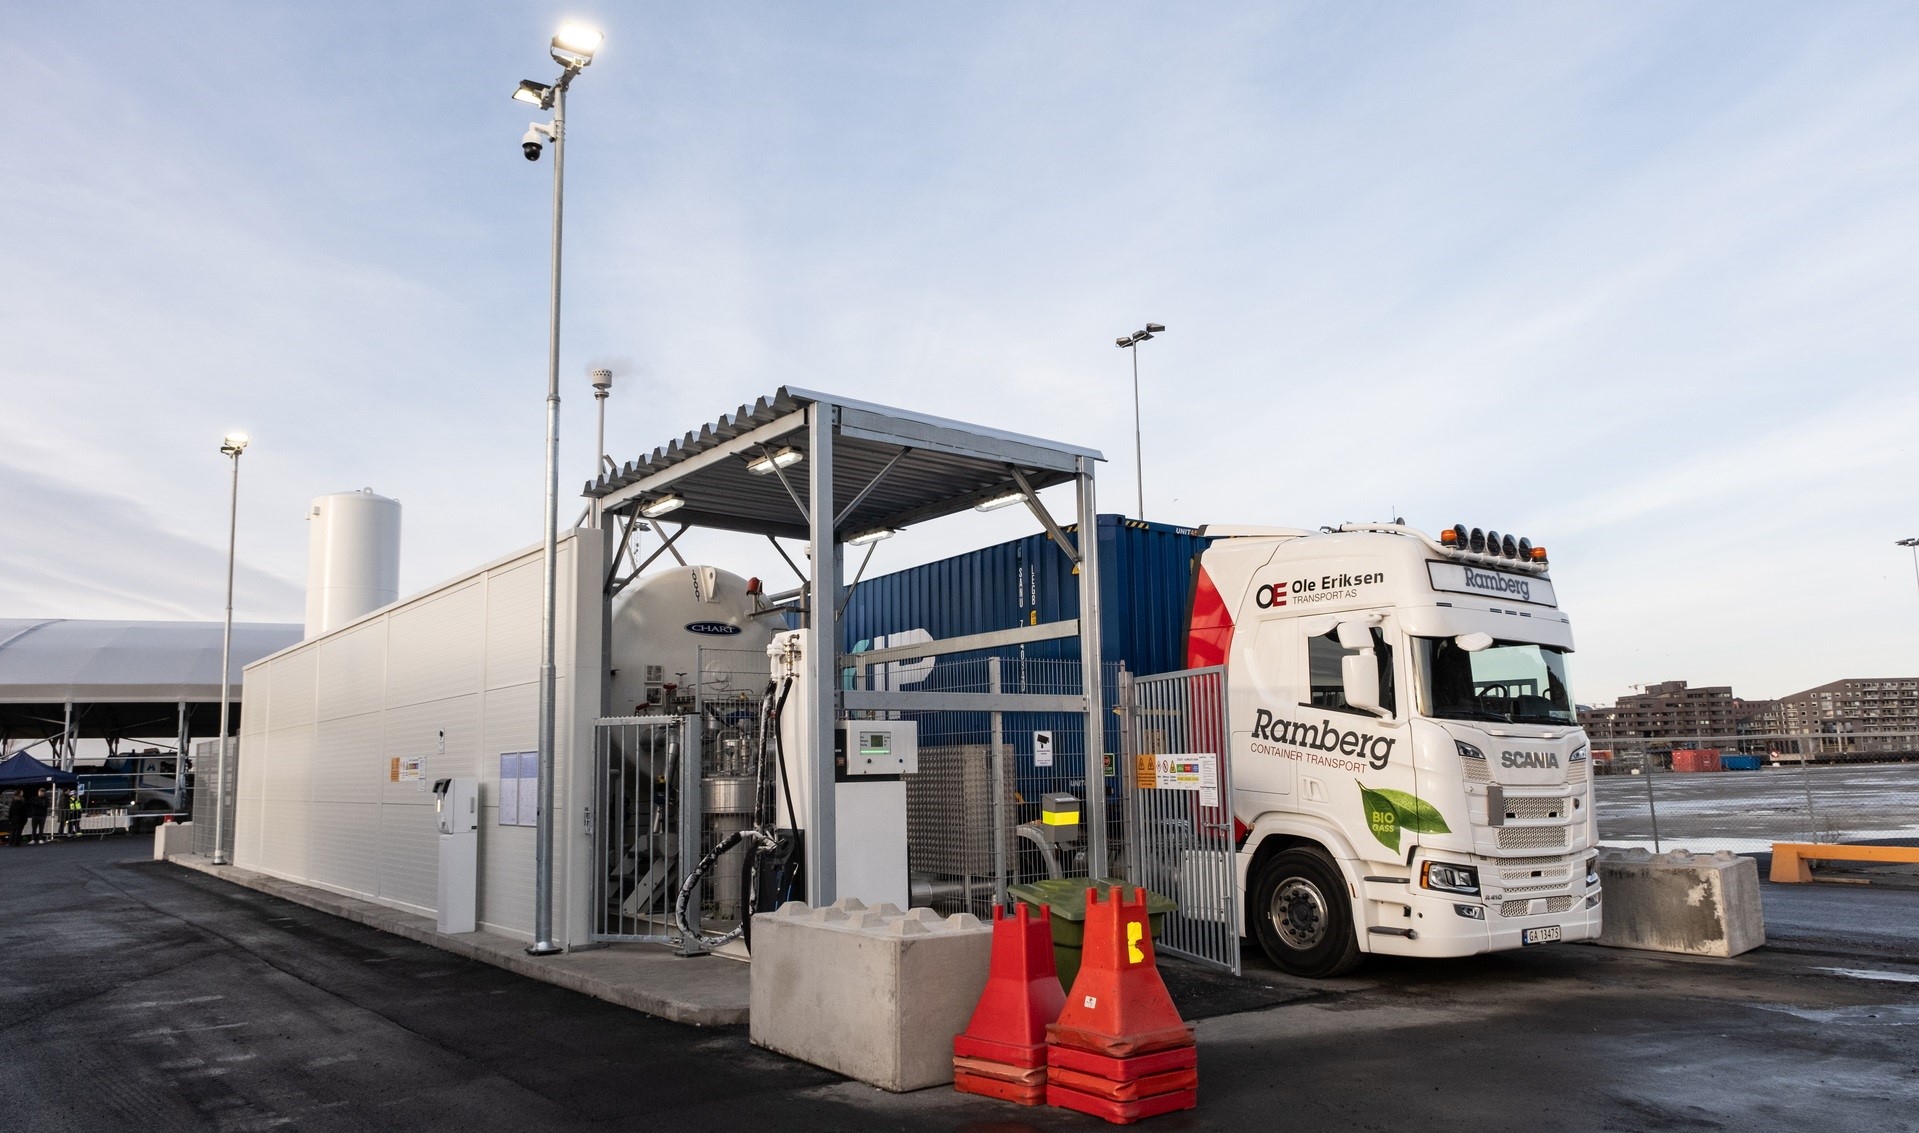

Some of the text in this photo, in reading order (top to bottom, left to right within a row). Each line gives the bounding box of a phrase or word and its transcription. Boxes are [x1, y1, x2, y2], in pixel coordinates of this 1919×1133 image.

[1291, 572, 1384, 594] Ole Eriksen
[1463, 567, 1530, 600] Ramberg
[1256, 582, 1288, 609] OE
[1292, 589, 1358, 605] TRANSPORT AS
[691, 625, 736, 633] CHART
[1251, 708, 1396, 771] Ramberg
[1250, 743, 1367, 774] CONTAINER TRANSPORT
[1501, 750, 1559, 769] SCANIA
[1372, 811, 1395, 824] BIO
[1372, 824, 1395, 832] GASS
[1529, 928, 1559, 942] GA 13475
